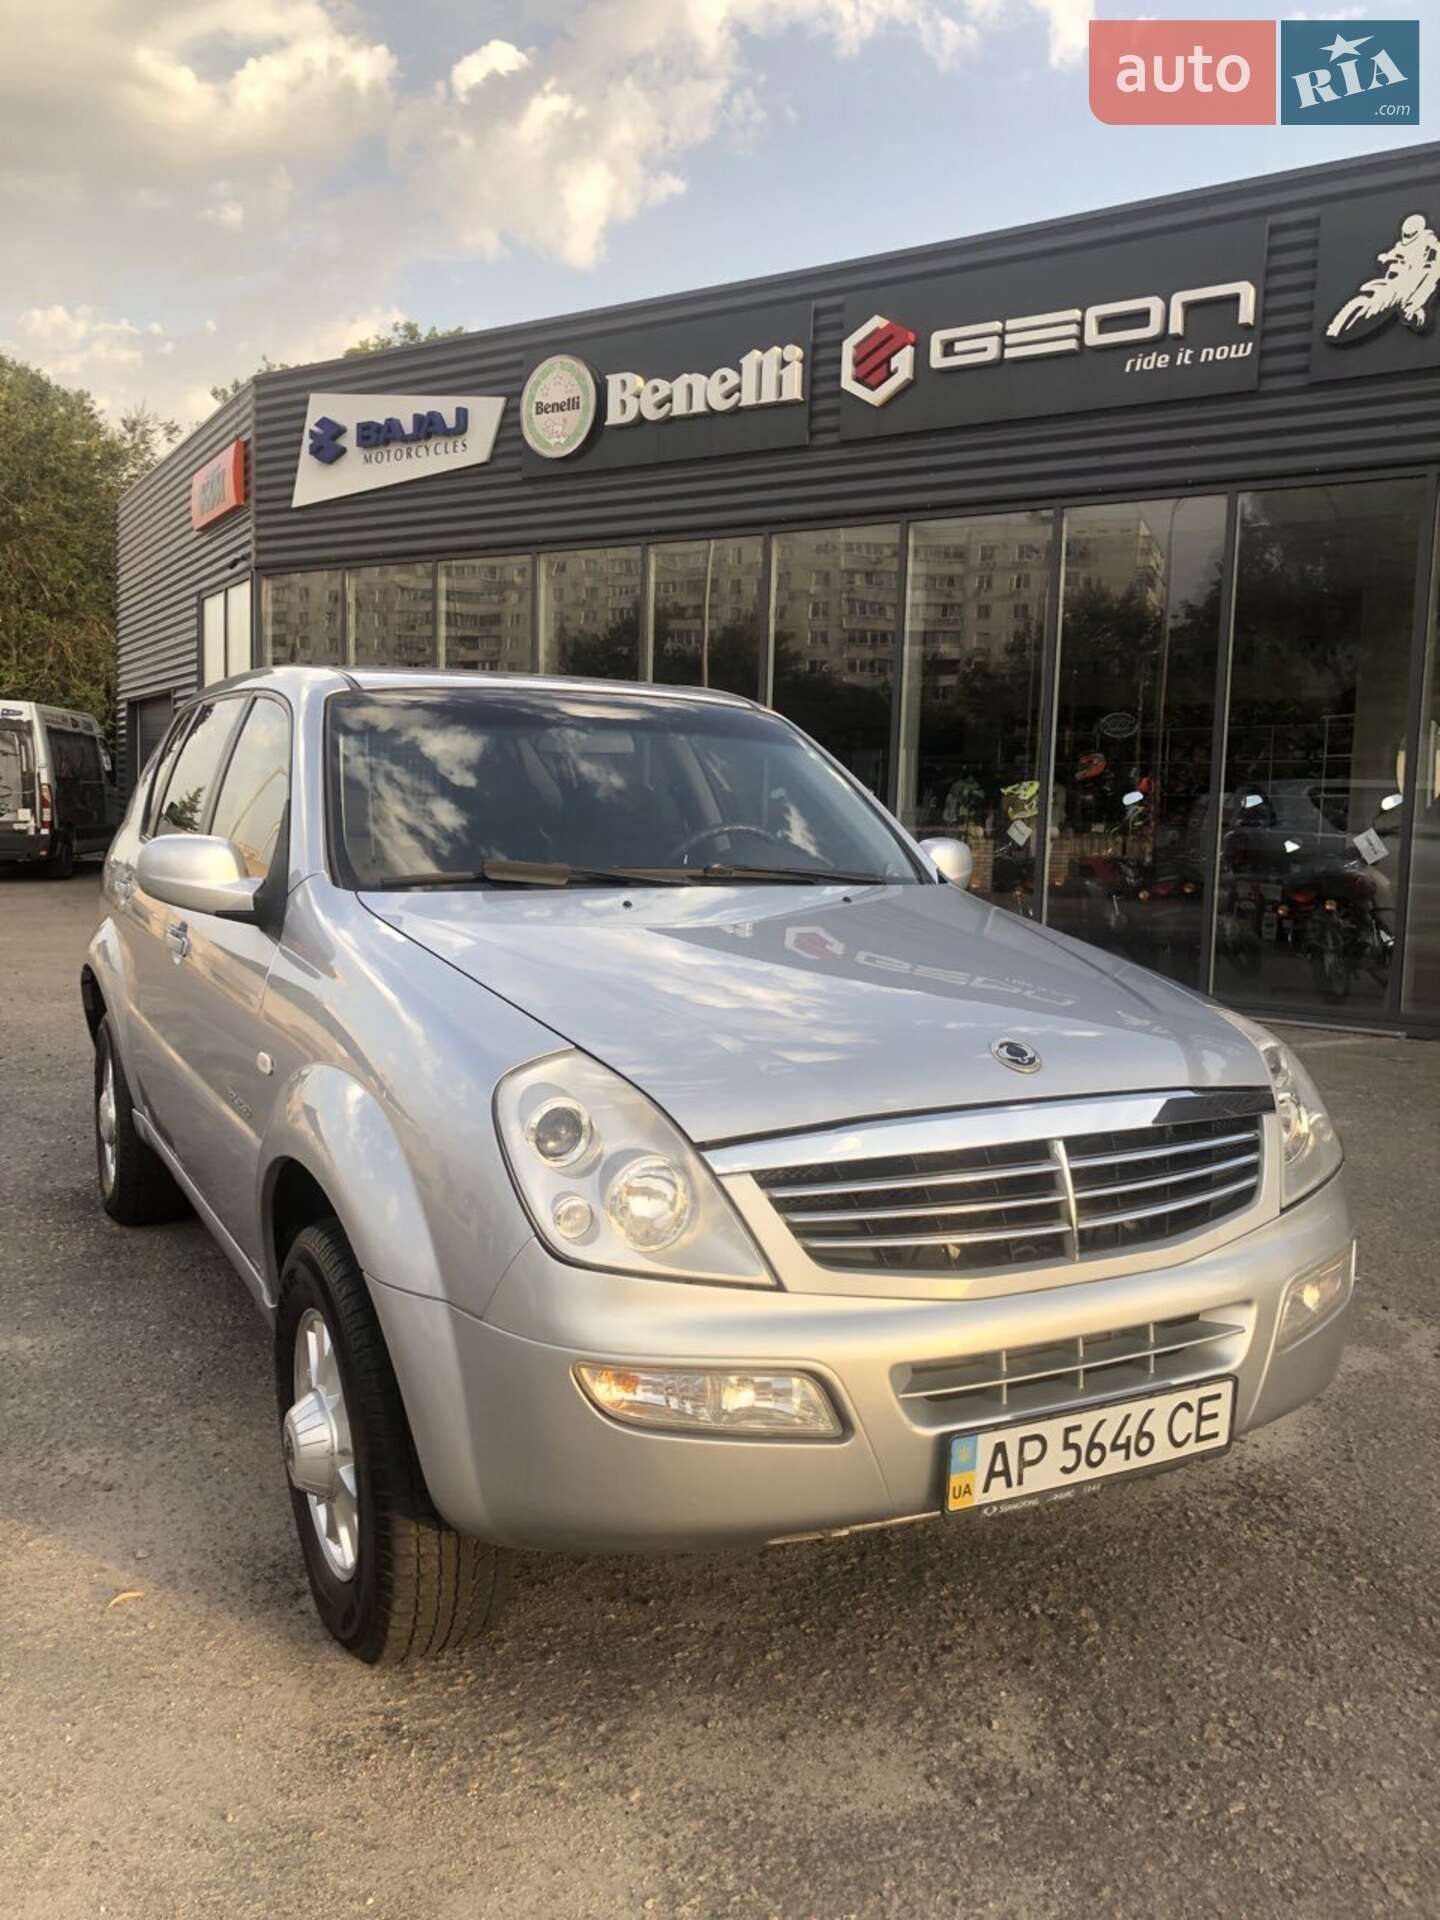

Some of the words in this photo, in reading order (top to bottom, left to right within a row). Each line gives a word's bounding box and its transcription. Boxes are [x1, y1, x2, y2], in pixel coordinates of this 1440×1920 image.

[1124, 351, 1171, 373] ride
[1175, 346, 1195, 366] it
[1199, 341, 1254, 363] now
[603, 344, 805, 427] Benelli
[534, 396, 581, 416] Benelli
[355, 406, 469, 449] BAJAJ
[362, 438, 468, 465] MOTORCYCLES
[981, 1432, 1048, 1494] AP
[1059, 1407, 1156, 1475] 5646
[1166, 1392, 1222, 1449] CE
[951, 1482, 973, 1500] UA
